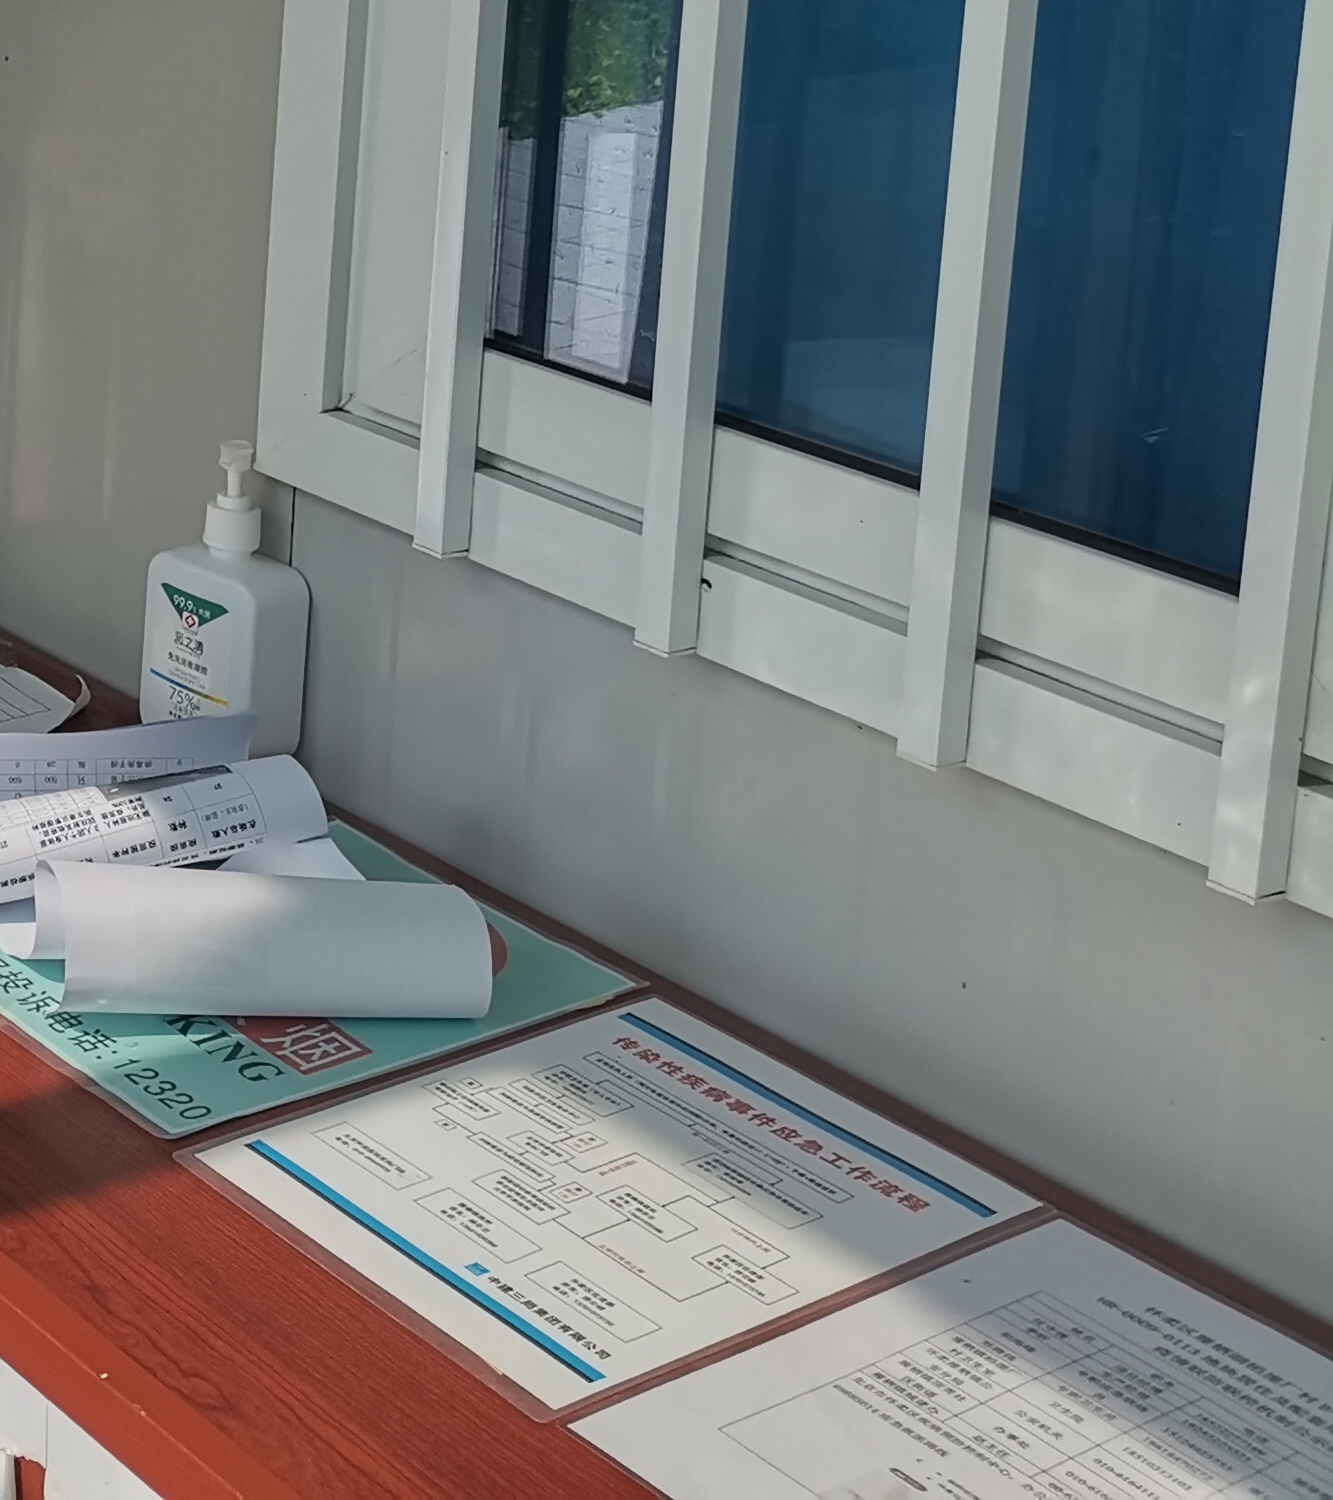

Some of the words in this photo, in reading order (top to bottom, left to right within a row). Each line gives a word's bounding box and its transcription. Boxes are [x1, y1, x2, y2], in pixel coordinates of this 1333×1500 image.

[612, 1034, 932, 1213] 传染性疾病事件应急工作流程
[488, 1274, 614, 1362] 中建三局集团有限公司
